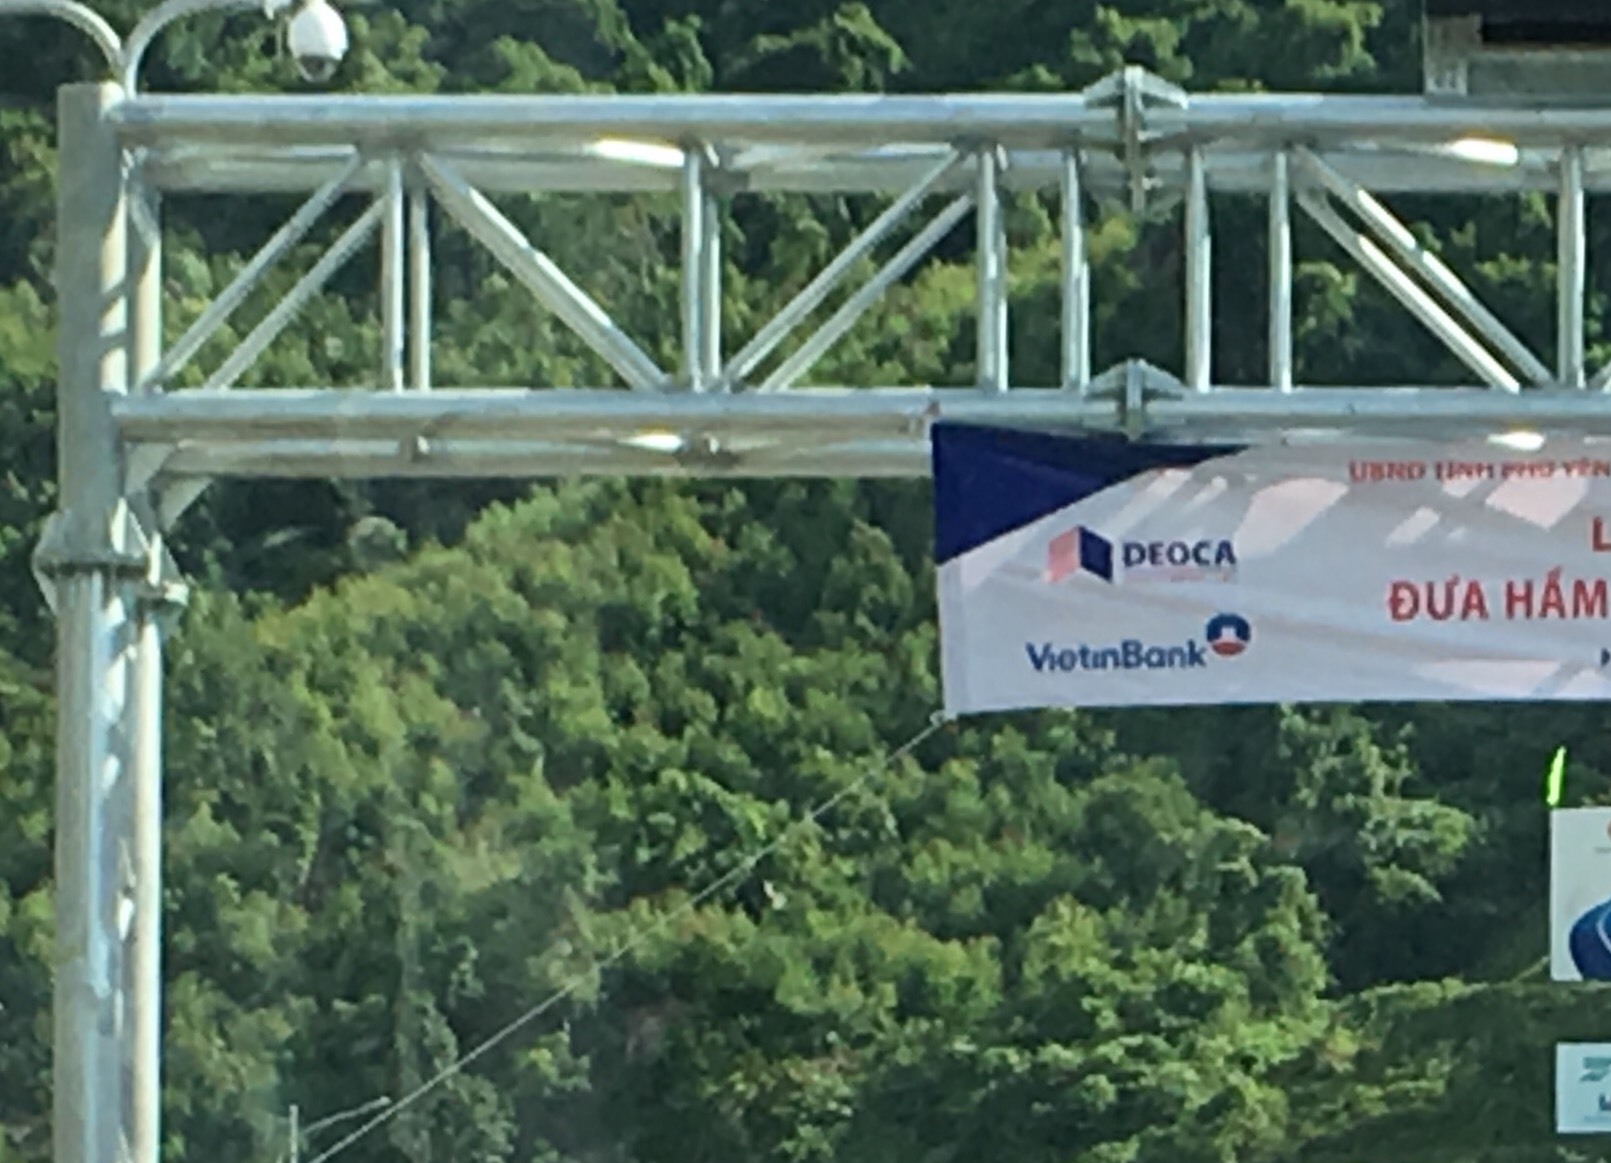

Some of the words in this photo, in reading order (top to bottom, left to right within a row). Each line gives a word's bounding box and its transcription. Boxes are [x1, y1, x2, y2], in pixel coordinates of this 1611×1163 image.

[1122, 539, 1236, 567] DEOCA
[1388, 573, 1489, 621] ĐƯA
[1025, 639, 1208, 672] VietinBank
